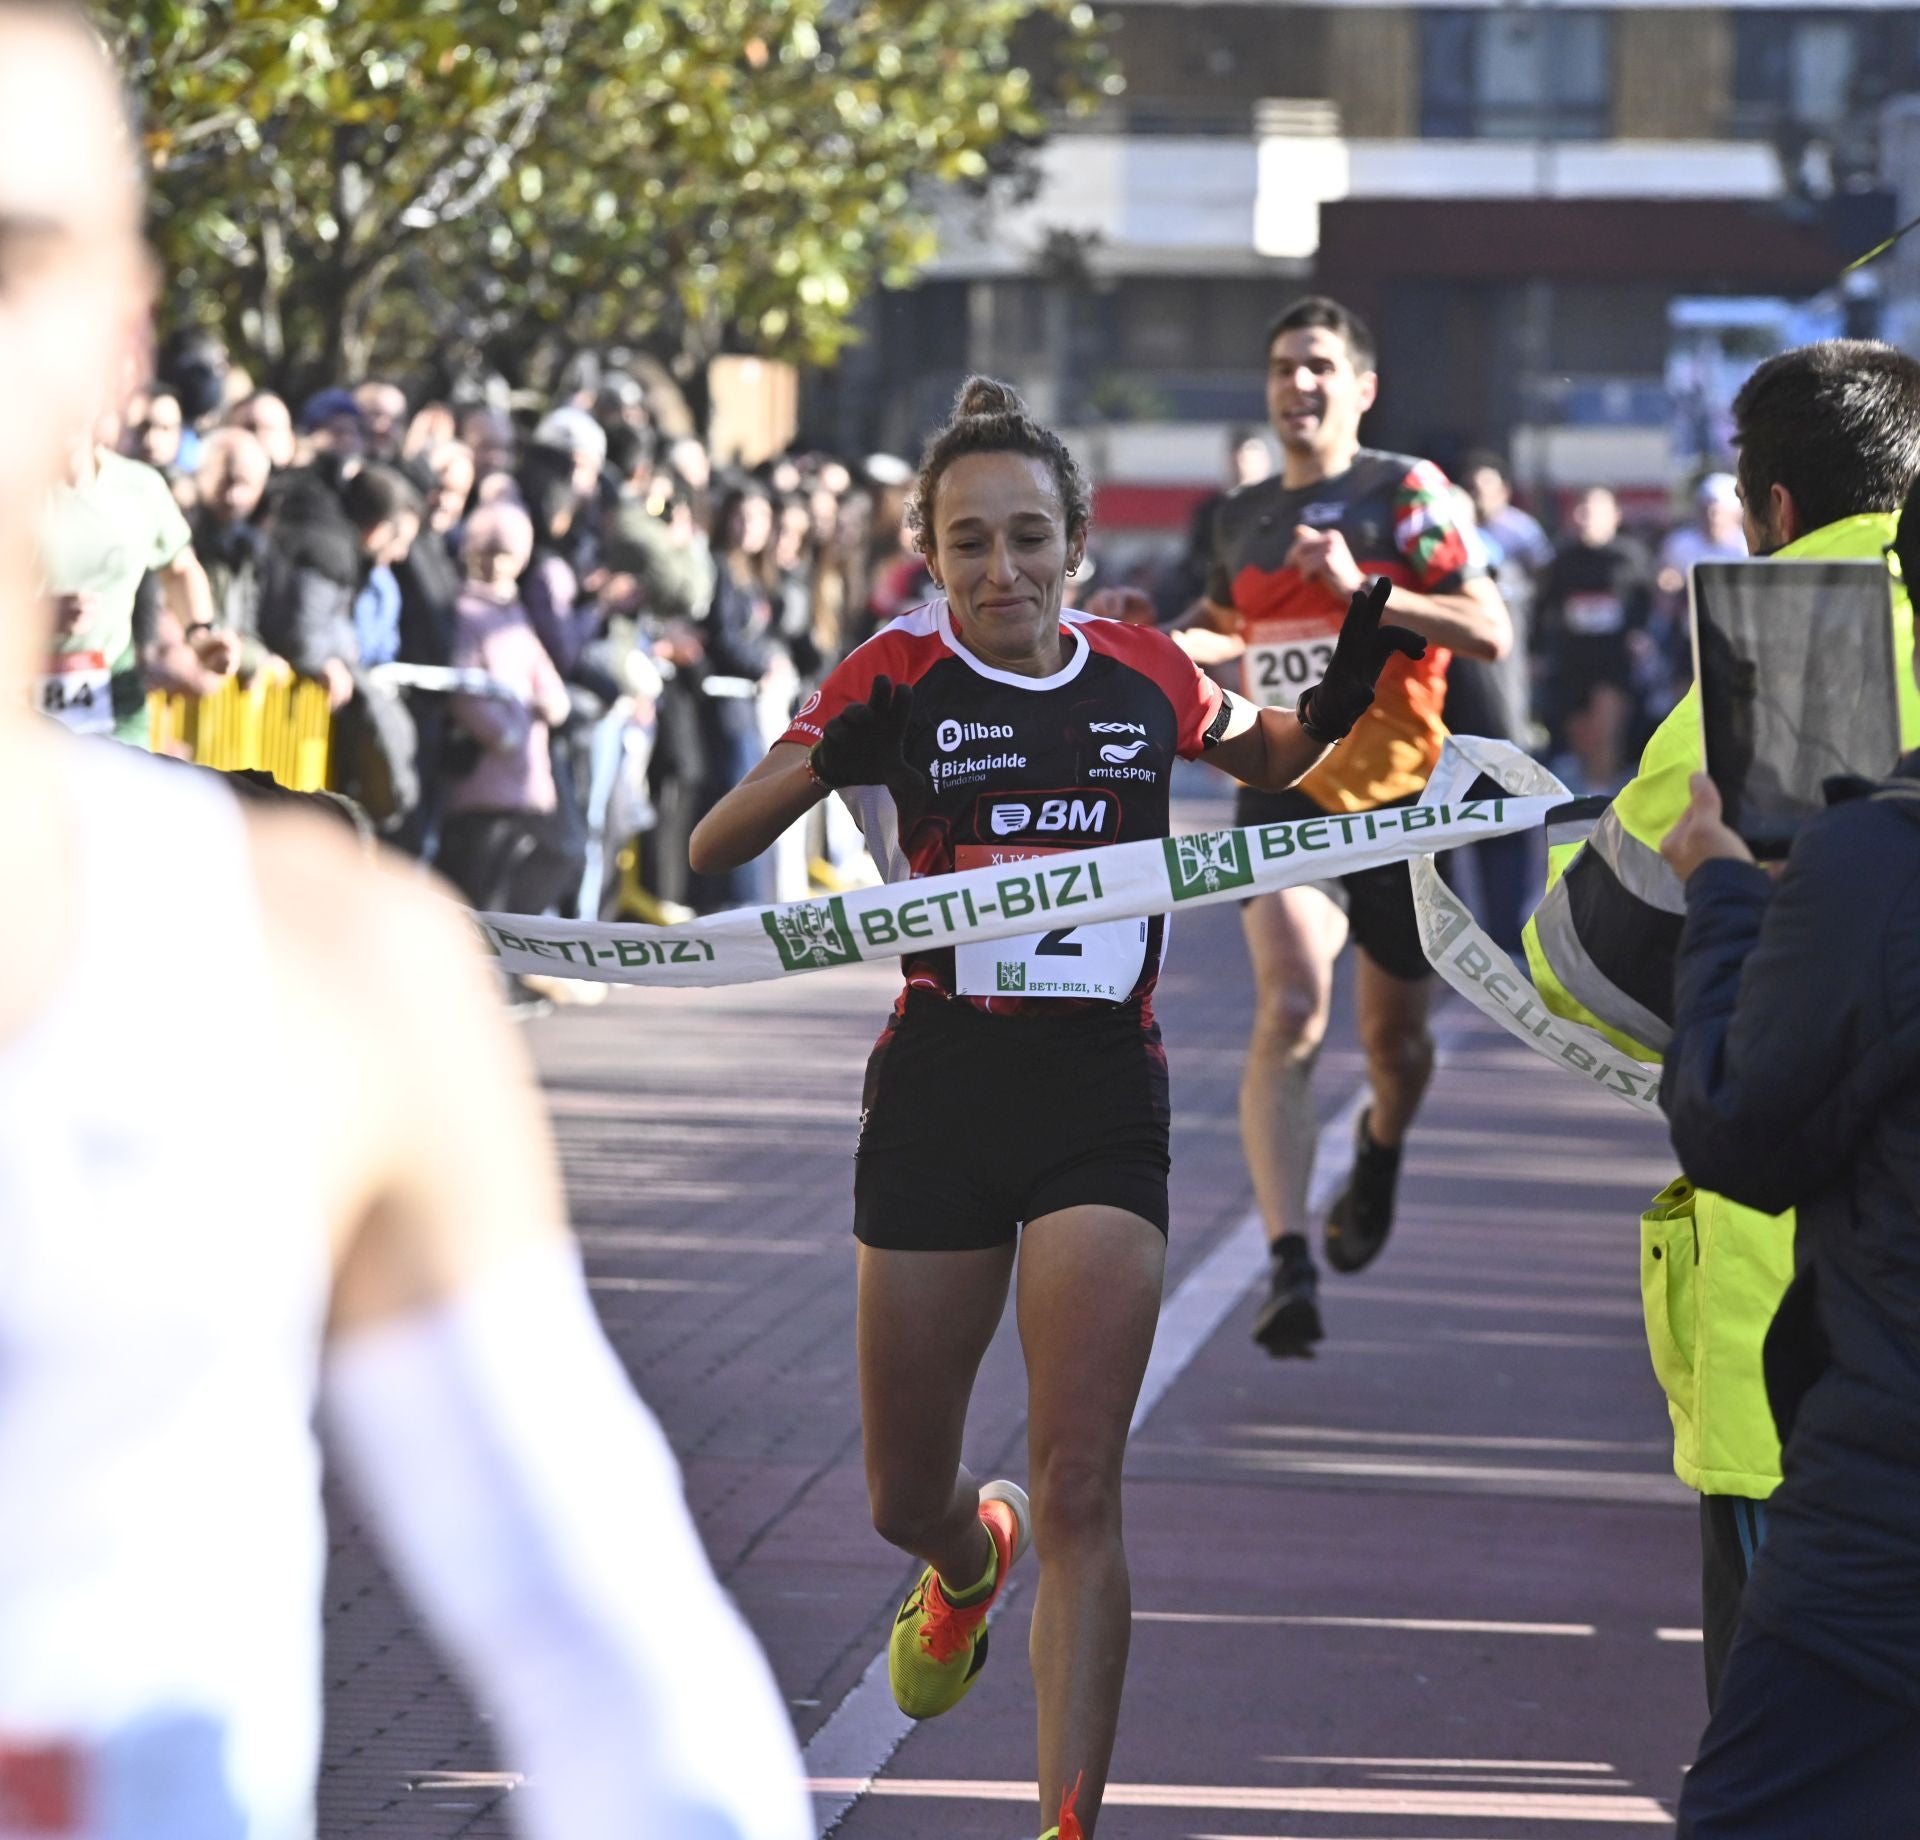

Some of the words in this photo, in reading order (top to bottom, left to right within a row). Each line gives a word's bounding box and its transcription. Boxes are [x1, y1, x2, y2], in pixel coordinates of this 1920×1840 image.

[937, 719, 1014, 752] Bilbao
[941, 753, 1027, 778] Bizkaialde
[1088, 767, 1157, 783] emteSPORT
[1036, 799, 1107, 833] BM
[1259, 799, 1503, 860] BETI-BIZI
[859, 861, 1103, 946] BETI-BIZI
[491, 925, 715, 968] BETI-BIZI
[1029, 982, 1090, 994] BETI-BIZI,
[1094, 983, 1105, 994] K.
[1108, 986, 1117, 996] E.
